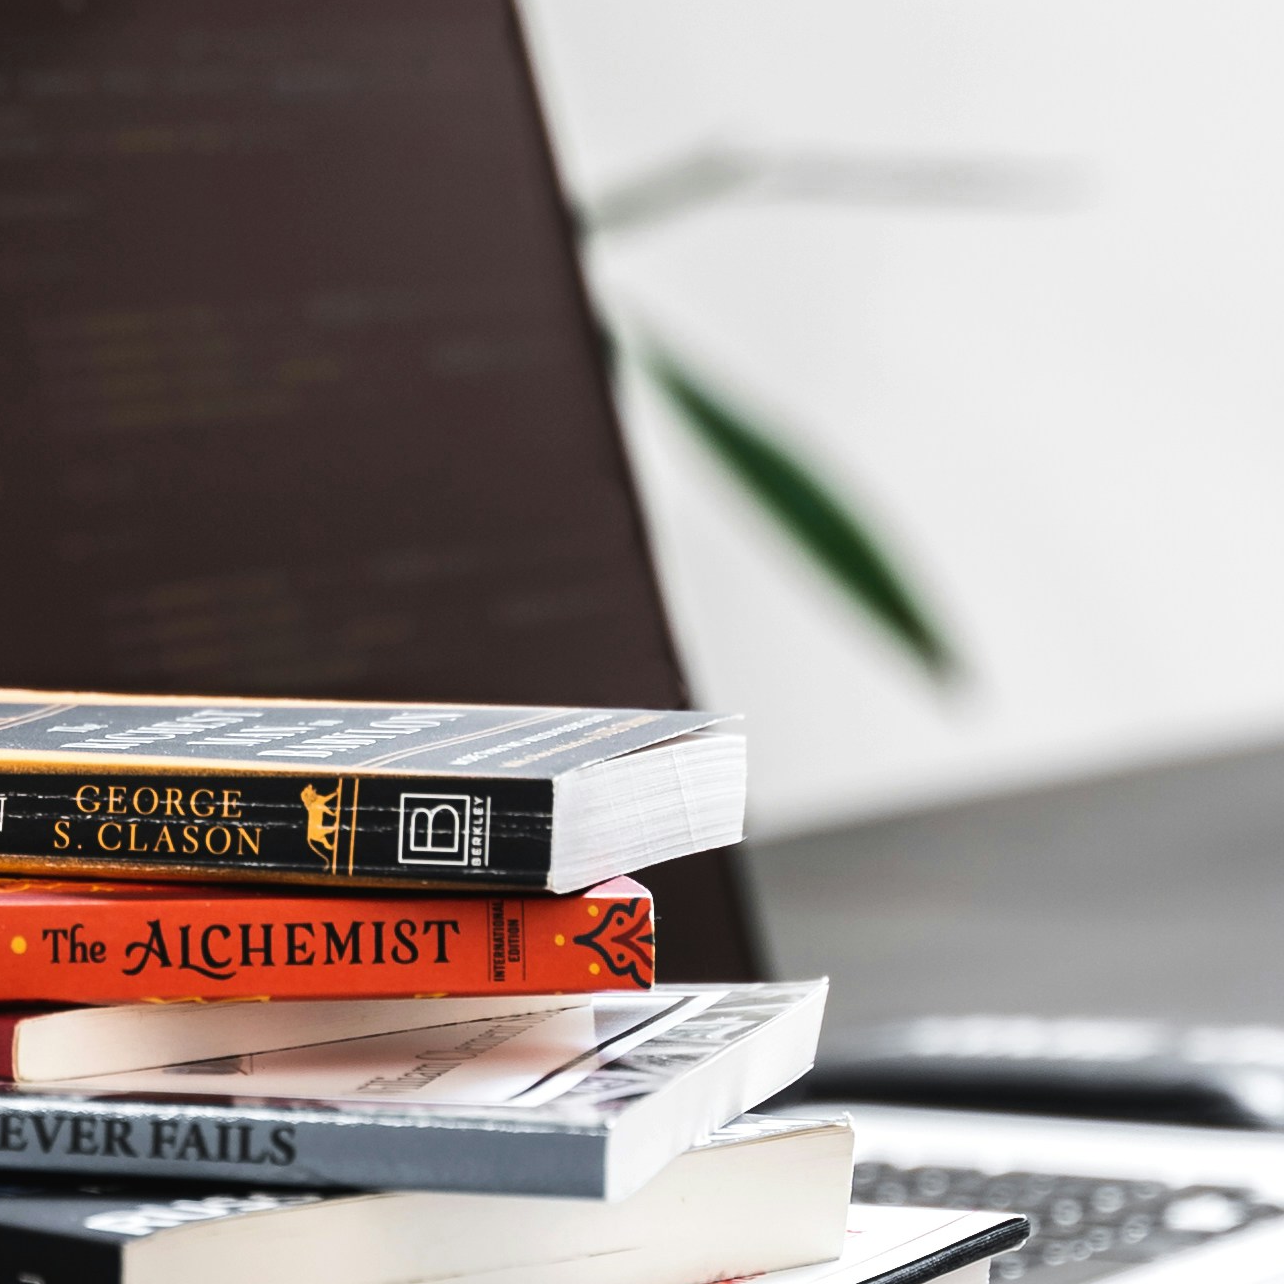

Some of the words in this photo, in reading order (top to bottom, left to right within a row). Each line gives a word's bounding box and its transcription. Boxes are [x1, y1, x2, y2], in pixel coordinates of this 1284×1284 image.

[75, 784, 244, 820] GEORGE
[53, 821, 87, 851] S.
[97, 822, 263, 857] CLASON
[471, 795, 485, 867] BERKLEY
[42, 927, 108, 965] The
[122, 918, 462, 981] ALCHEMIST
[492, 899, 506, 983] INTERNATIONAL
[507, 919, 521, 963] EDITION
[150, 1117, 299, 1167] FAILS
